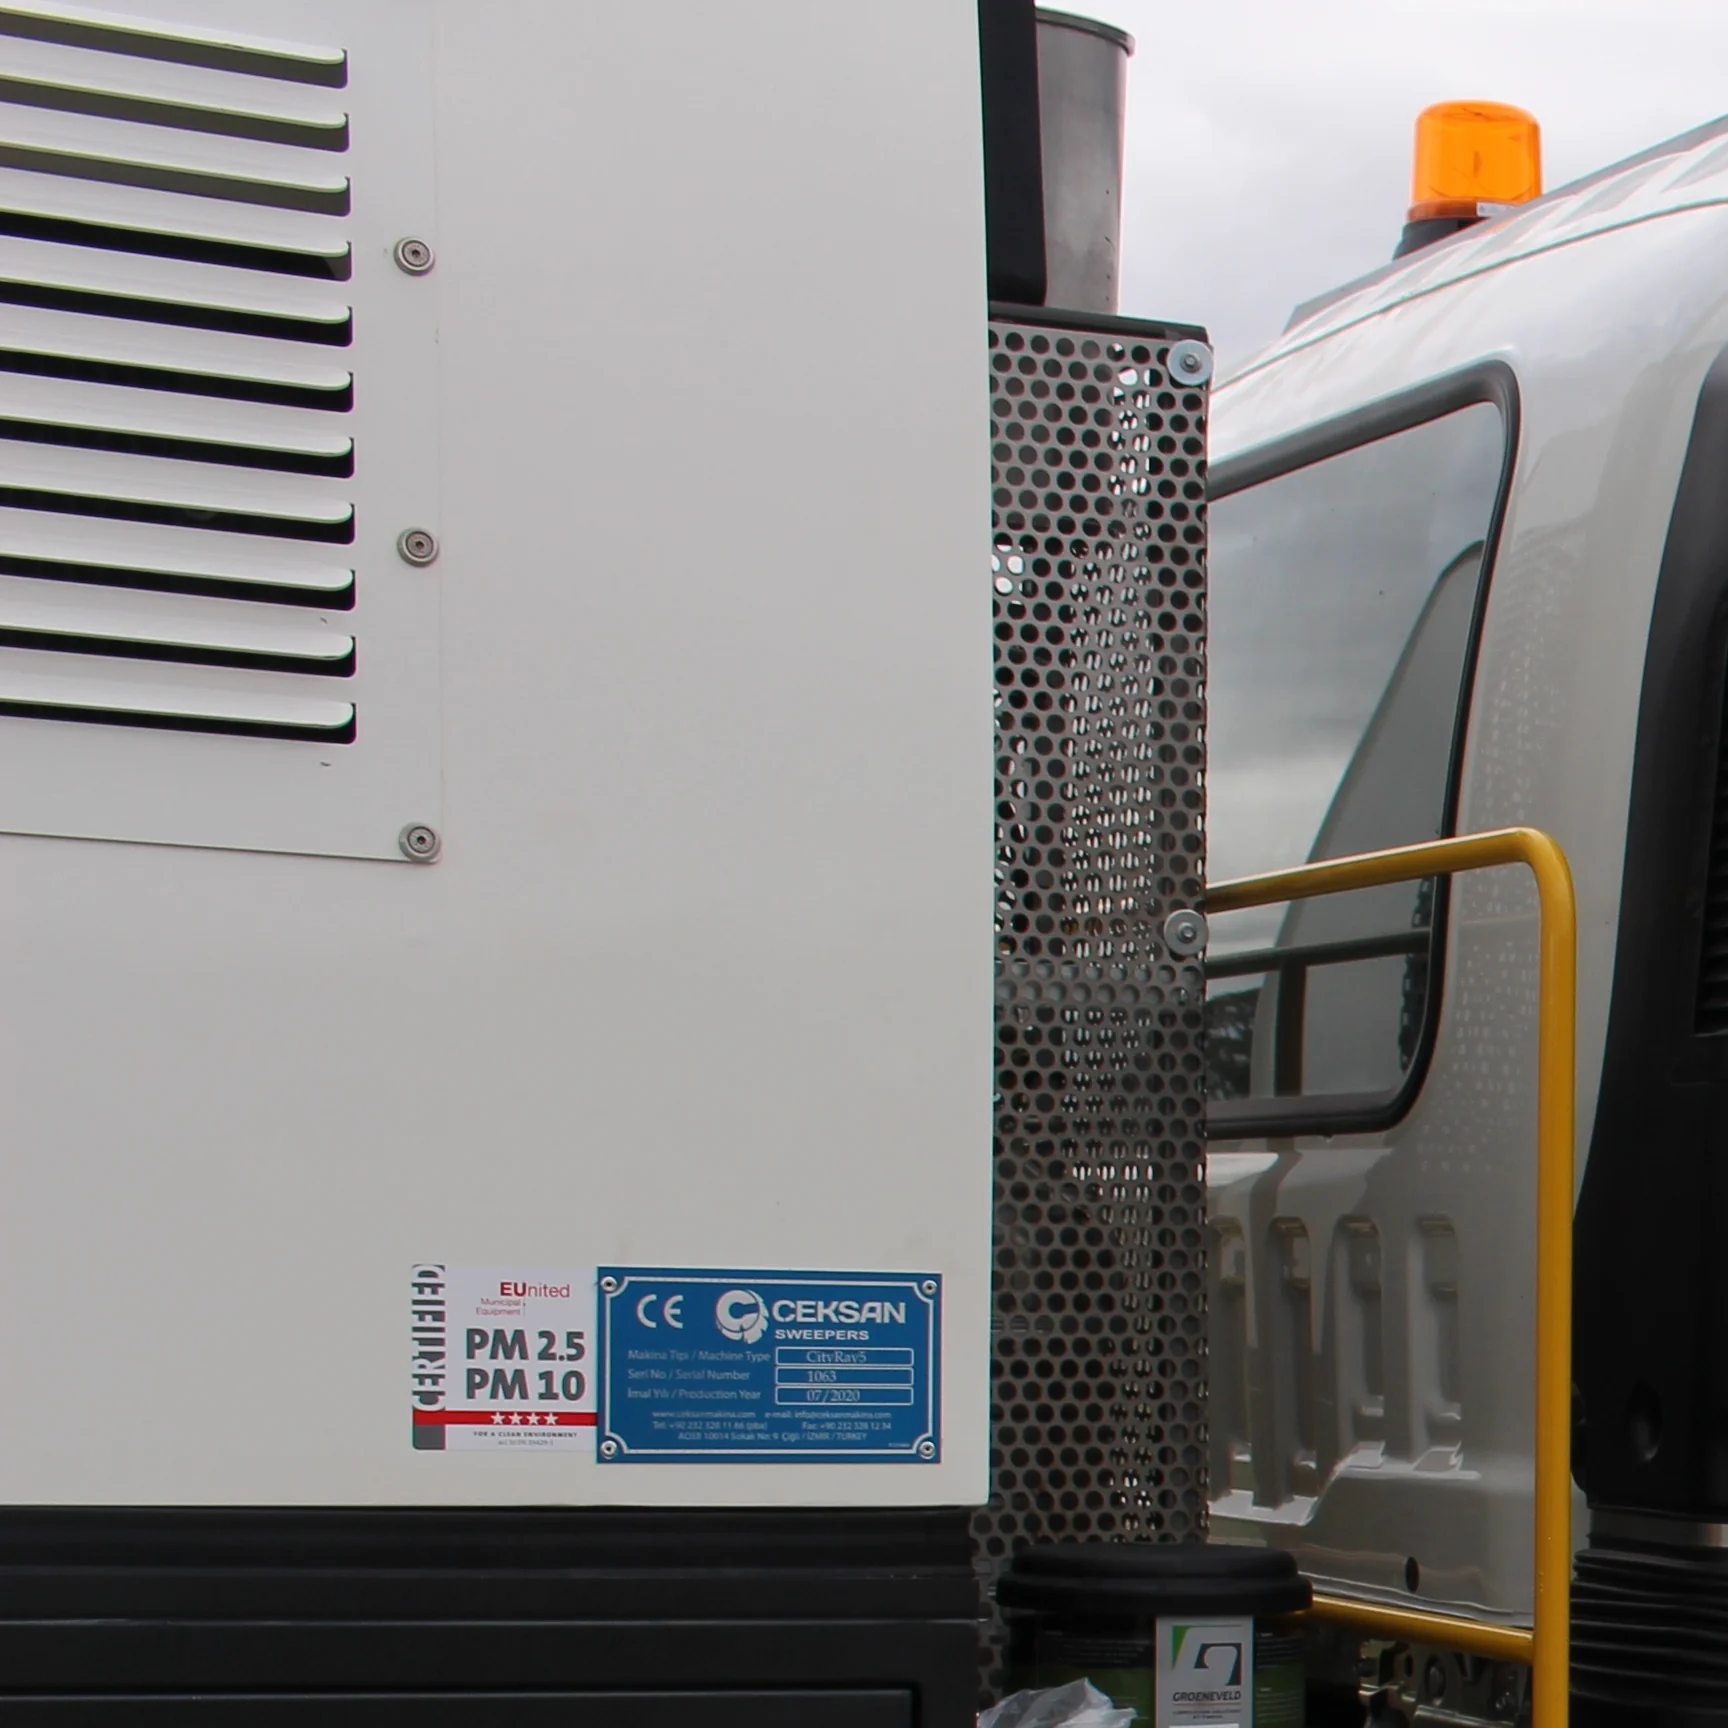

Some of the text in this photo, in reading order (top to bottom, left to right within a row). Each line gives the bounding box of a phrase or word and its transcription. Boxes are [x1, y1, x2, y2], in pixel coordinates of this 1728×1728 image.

[500, 1281, 571, 1298] EUnited
[481, 1298, 521, 1307] Municipal
[476, 1307, 521, 1316] Equipment
[636, 1294, 684, 1329] CE
[772, 1299, 907, 1325] CEKSAN
[412, 1265, 446, 1411] CERTIFIED
[774, 1329, 870, 1341] SWEEPERS
[466, 1328, 586, 1362] PM 2.5
[627, 1350, 667, 1360] Makina
[698, 1350, 744, 1361] Machine
[746, 1351, 771, 1363] Type
[806, 1350, 868, 1364] CityRay5
[650, 1369, 667, 1380] No
[675, 1369, 706, 1380] Serial
[707, 1370, 751, 1381] Number
[807, 1370, 837, 1383] 1063
[466, 1368, 586, 1401] PM 10
[678, 1388, 737, 1399] Production
[739, 1389, 762, 1399] Year
[1172, 1691, 1242, 1702] GROENEVELD
